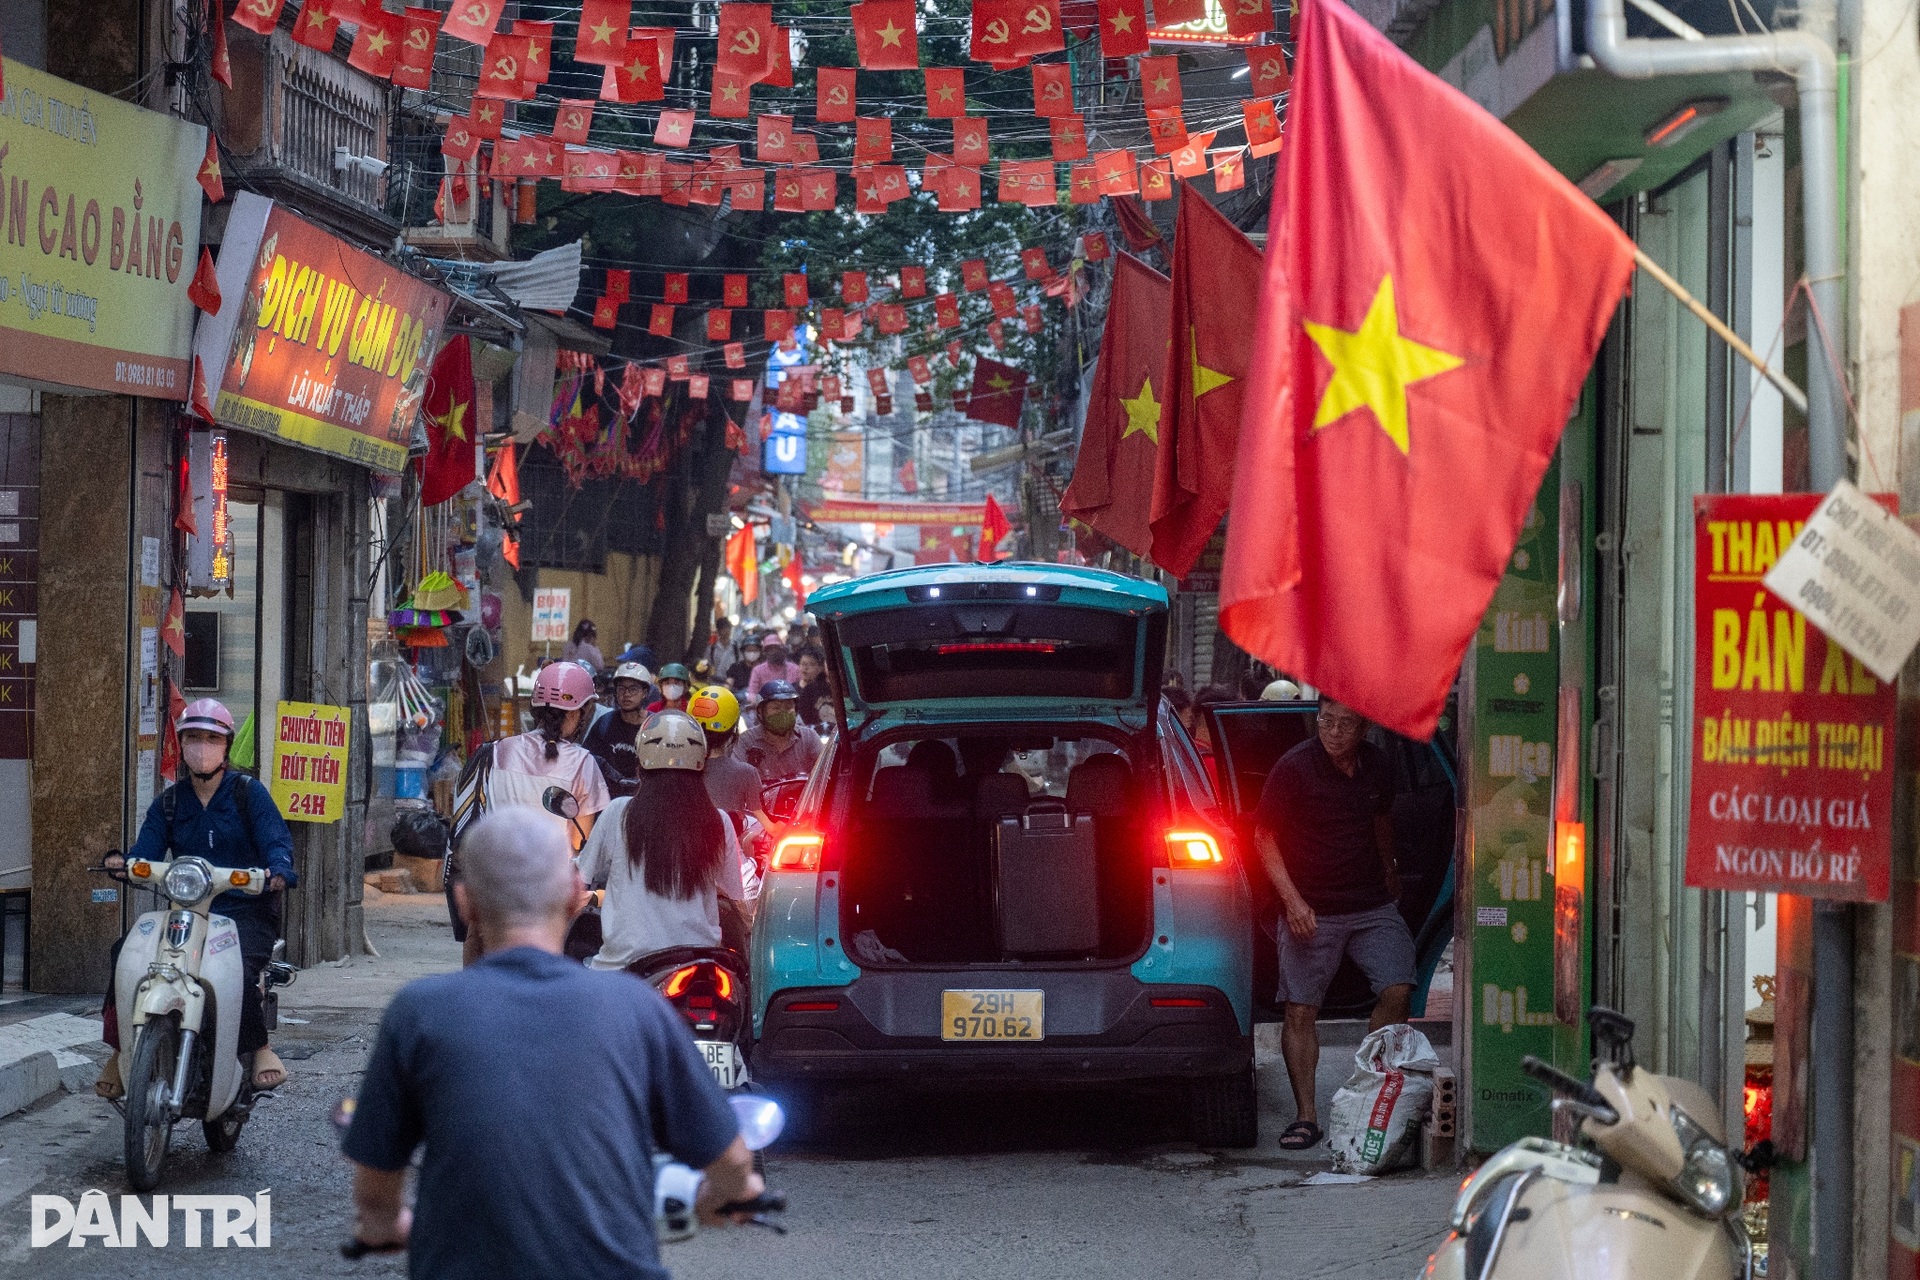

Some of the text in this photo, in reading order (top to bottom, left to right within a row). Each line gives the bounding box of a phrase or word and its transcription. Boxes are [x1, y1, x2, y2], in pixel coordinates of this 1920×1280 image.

[38, 186, 100, 266] CAO
[257, 254, 325, 354] DỊCH
[316, 278, 356, 375] VỤ
[1712, 590, 1806, 693] BÁN
[280, 709, 322, 745] CHUYỂN
[1703, 708, 1750, 764] BÁN
[1816, 721, 1883, 782] THOẠI
[280, 752, 340, 784] RÚT TIỀN
[288, 792, 326, 816] 24H
[1708, 785, 1871, 832] CÁC LOẠI GIÁ
[1714, 844, 1784, 877] NGON
[971, 993, 1015, 1015] 29H
[953, 1016, 1032, 1038] 970.62
